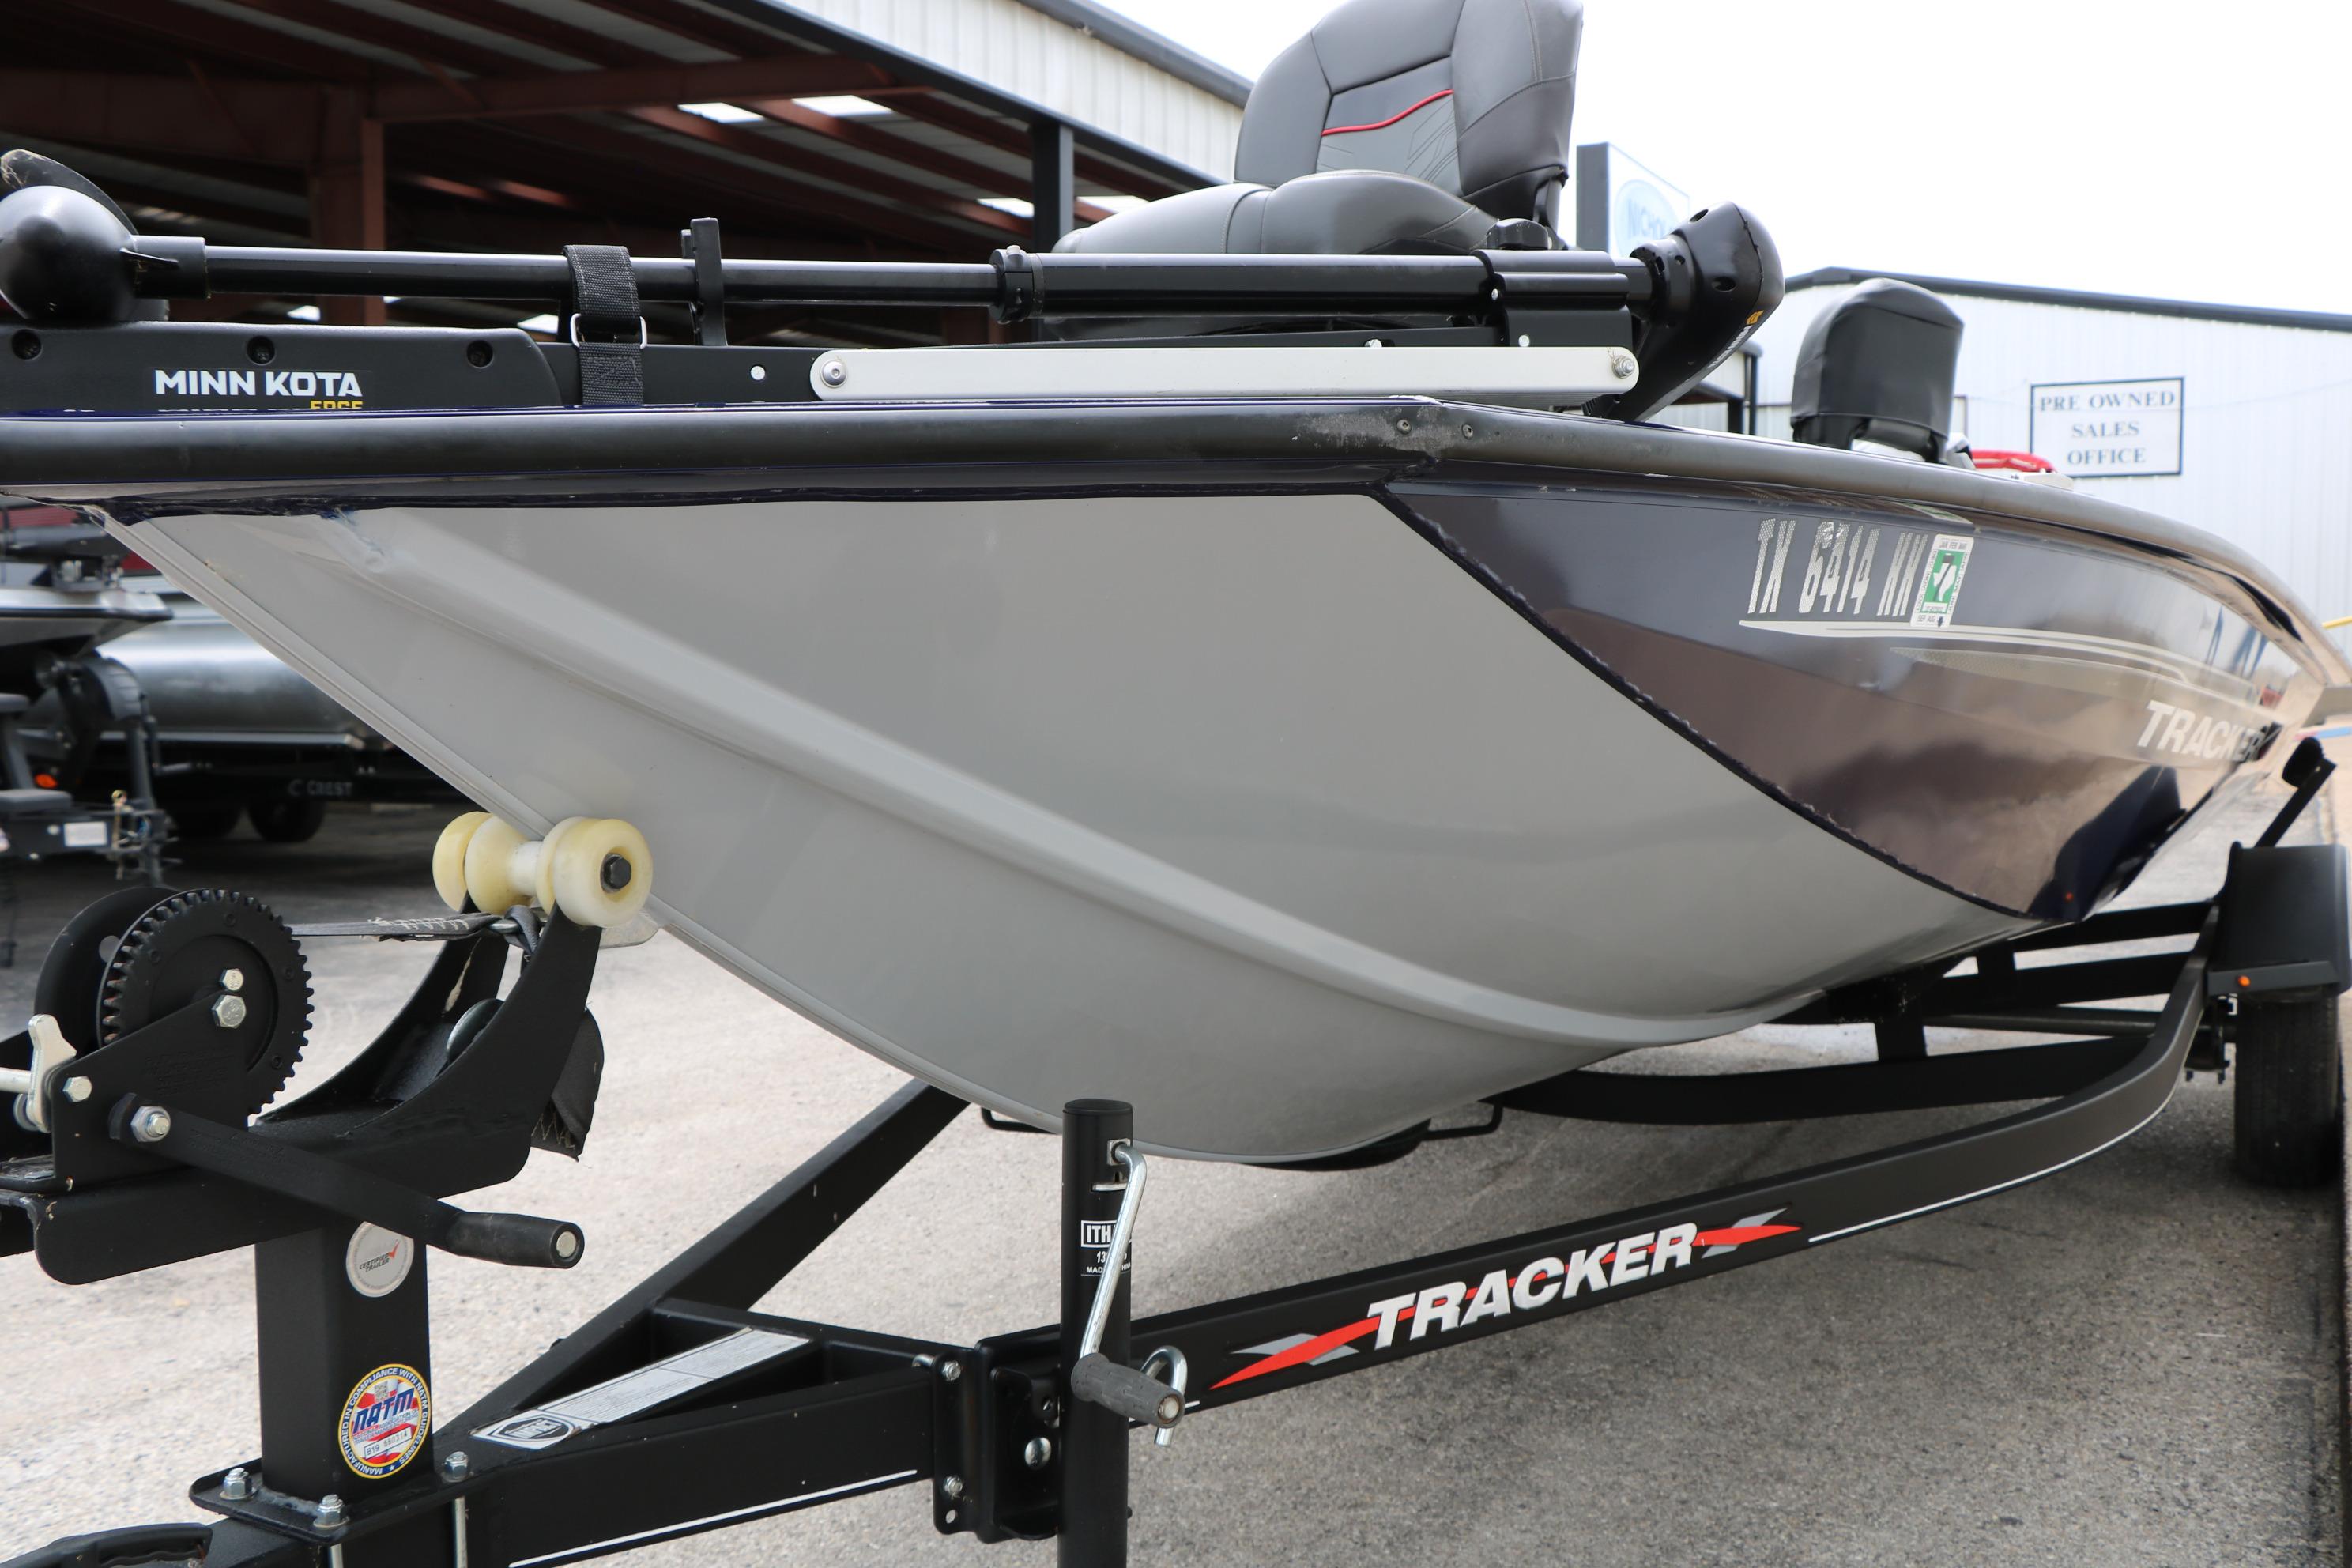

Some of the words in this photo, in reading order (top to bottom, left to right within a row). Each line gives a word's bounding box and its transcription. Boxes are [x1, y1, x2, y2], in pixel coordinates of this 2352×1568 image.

[155, 370, 256, 396] MINN
[265, 371, 363, 397] KOTA
[2040, 394, 2079, 411] PRE
[2090, 391, 2174, 409] OWNED
[2072, 421, 2139, 439] SALES
[2067, 448, 2146, 465] OFFICE
[1747, 518, 1796, 614] TX
[1798, 521, 1881, 614] 6414
[2136, 699, 2263, 761] TRACKER
[307, 780, 352, 796] CREST
[1087, 1224, 1116, 1243] ITH
[365, 1257, 390, 1272] TRAILER
[1367, 1221, 1698, 1349] TRACKER
[349, 1368, 398, 1405] COMPLIANCE
[399, 1369, 417, 1385] WITH
[415, 1381, 429, 1409] NATM
[345, 1407, 352, 1420] IN
[399, 1410, 428, 1465] GUIDELINES
[341, 1423, 383, 1476] MANUFACTURED
[367, 1445, 380, 1456] B19
